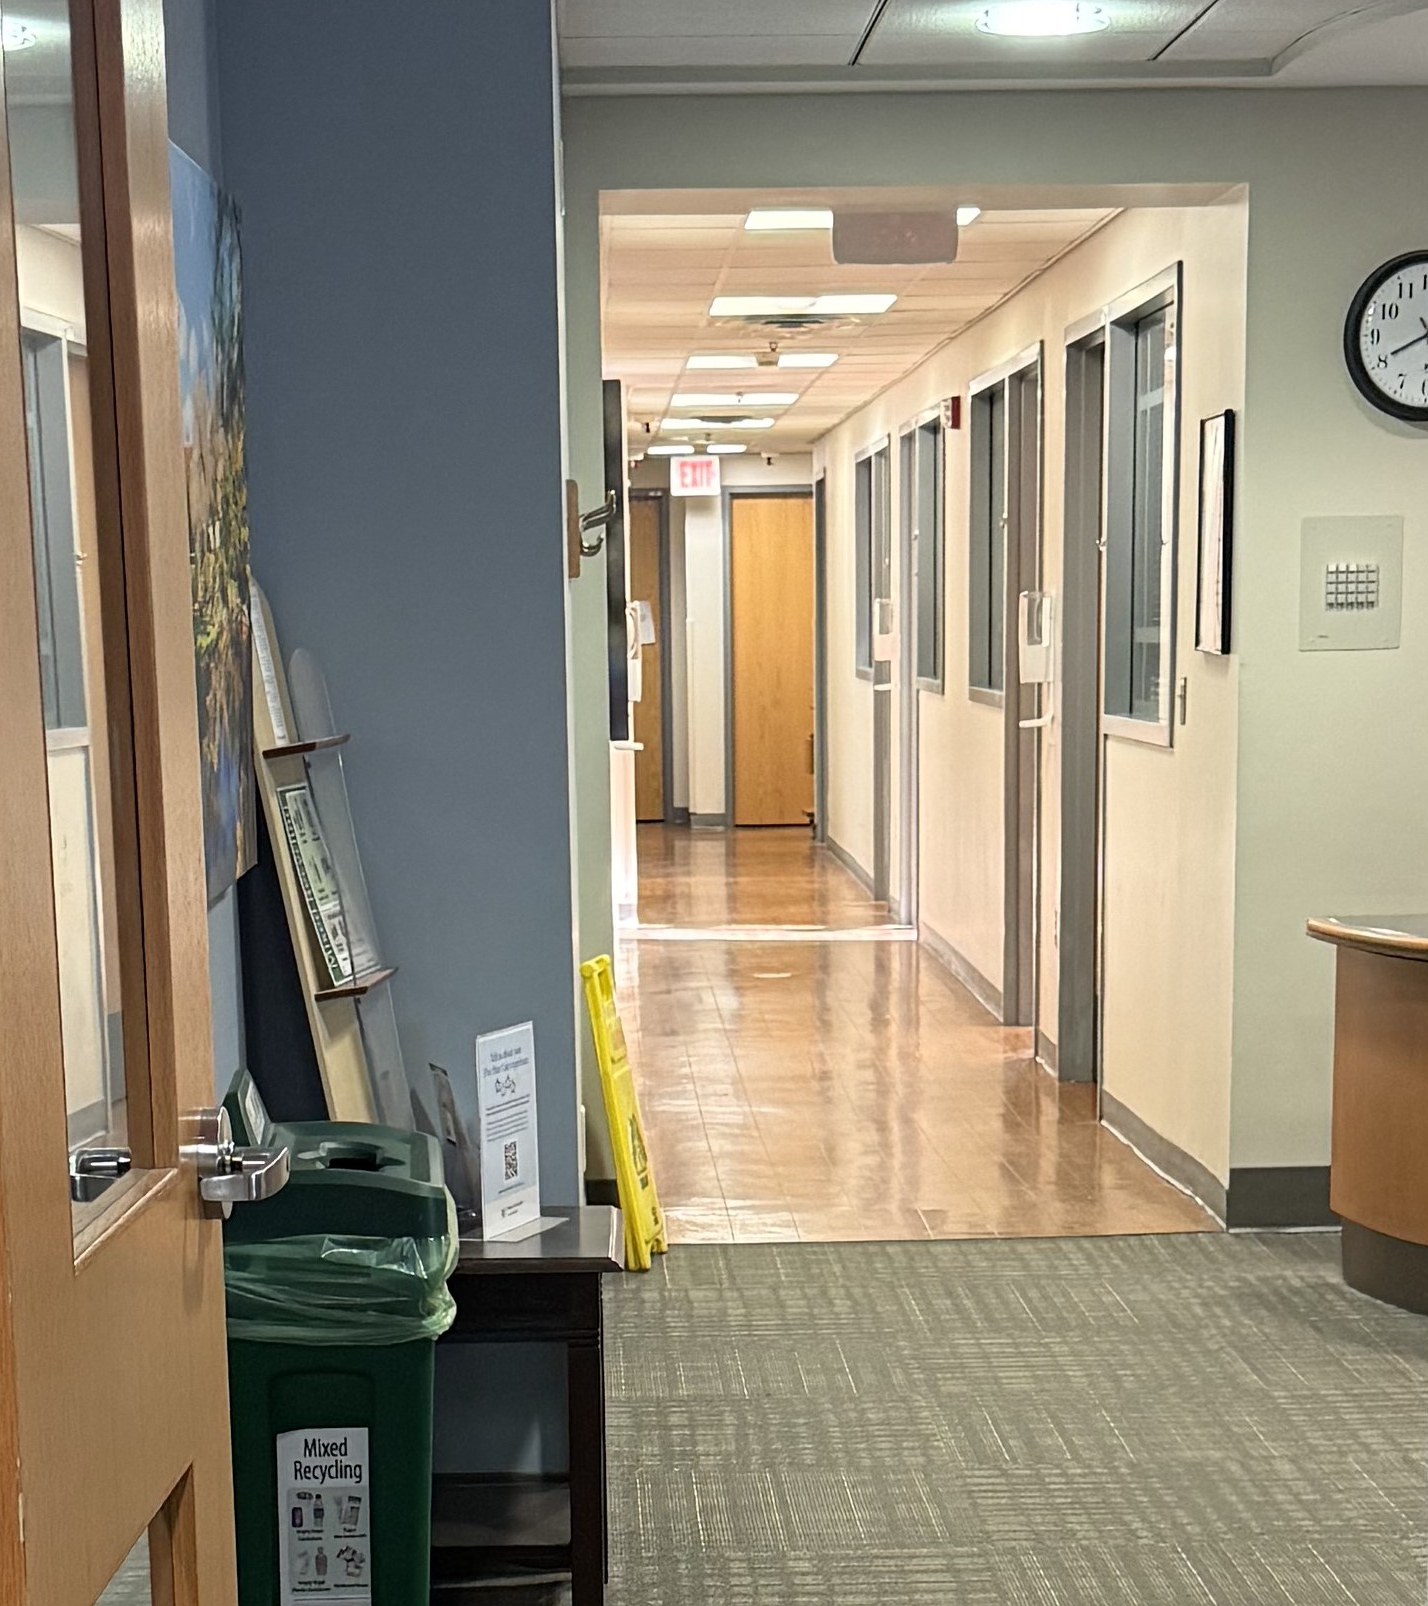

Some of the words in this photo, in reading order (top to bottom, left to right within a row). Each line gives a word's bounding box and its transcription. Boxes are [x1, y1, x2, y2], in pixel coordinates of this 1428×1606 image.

[1397, 282, 1414, 299] 11
[1380, 303, 1399, 320] 10
[1370, 328, 1380, 345] 9
[1377, 354, 1388, 369] 8
[1397, 373, 1407, 389] 7
[679, 460, 713, 488] EXIT
[303, 1436, 348, 1458] Mixed
[293, 1459, 363, 1484] Recycling
